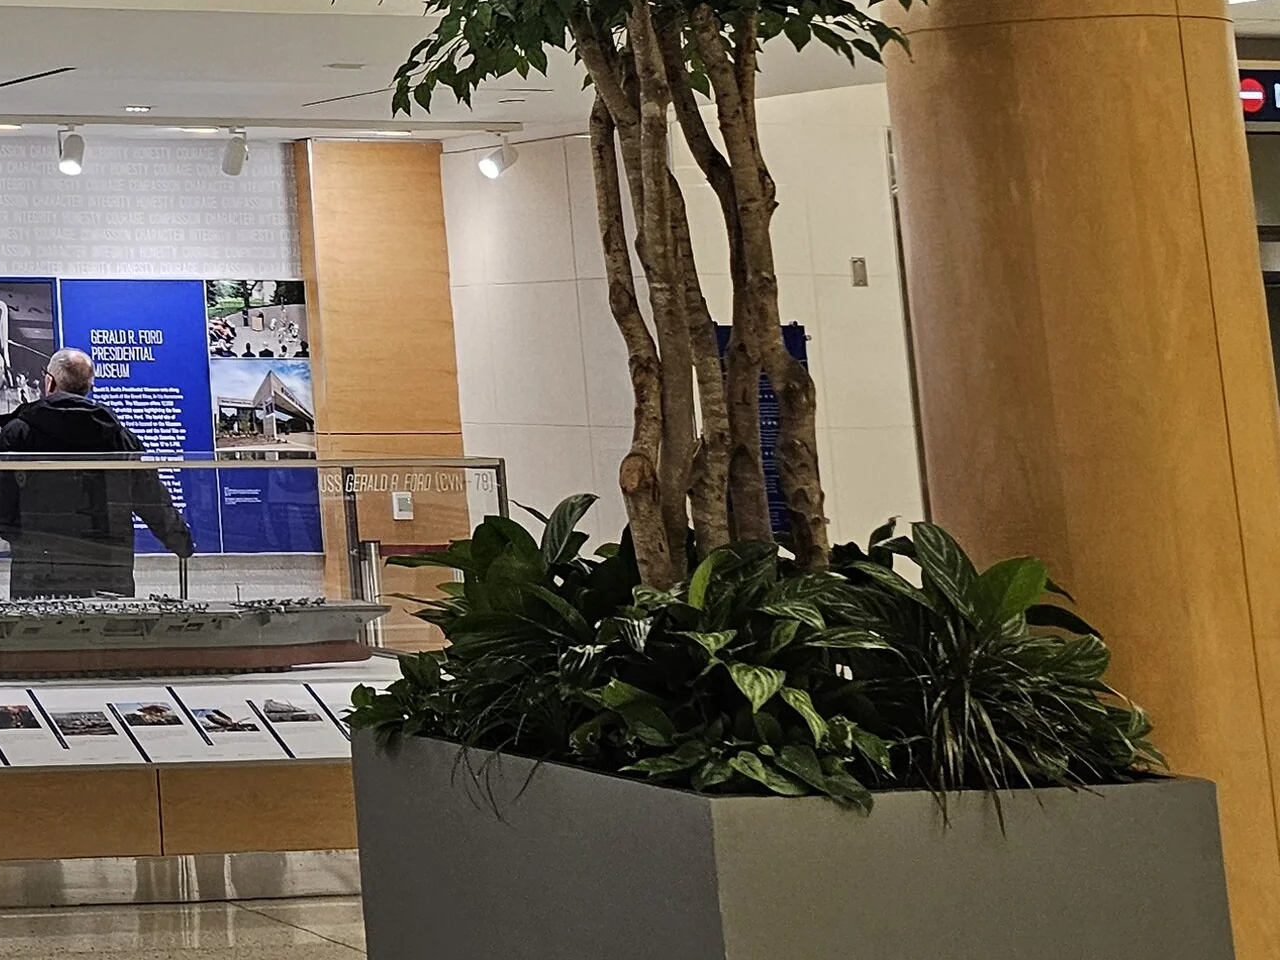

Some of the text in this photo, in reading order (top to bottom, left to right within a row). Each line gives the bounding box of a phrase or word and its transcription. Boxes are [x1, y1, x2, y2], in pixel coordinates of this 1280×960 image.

[91, 329, 163, 344] GERALD R. FORD
[91, 347, 155, 360] PRESIDENTIAL
[321, 474, 341, 492] USS
[345, 474, 387, 492] GERALD
[404, 474, 430, 491] FORD
